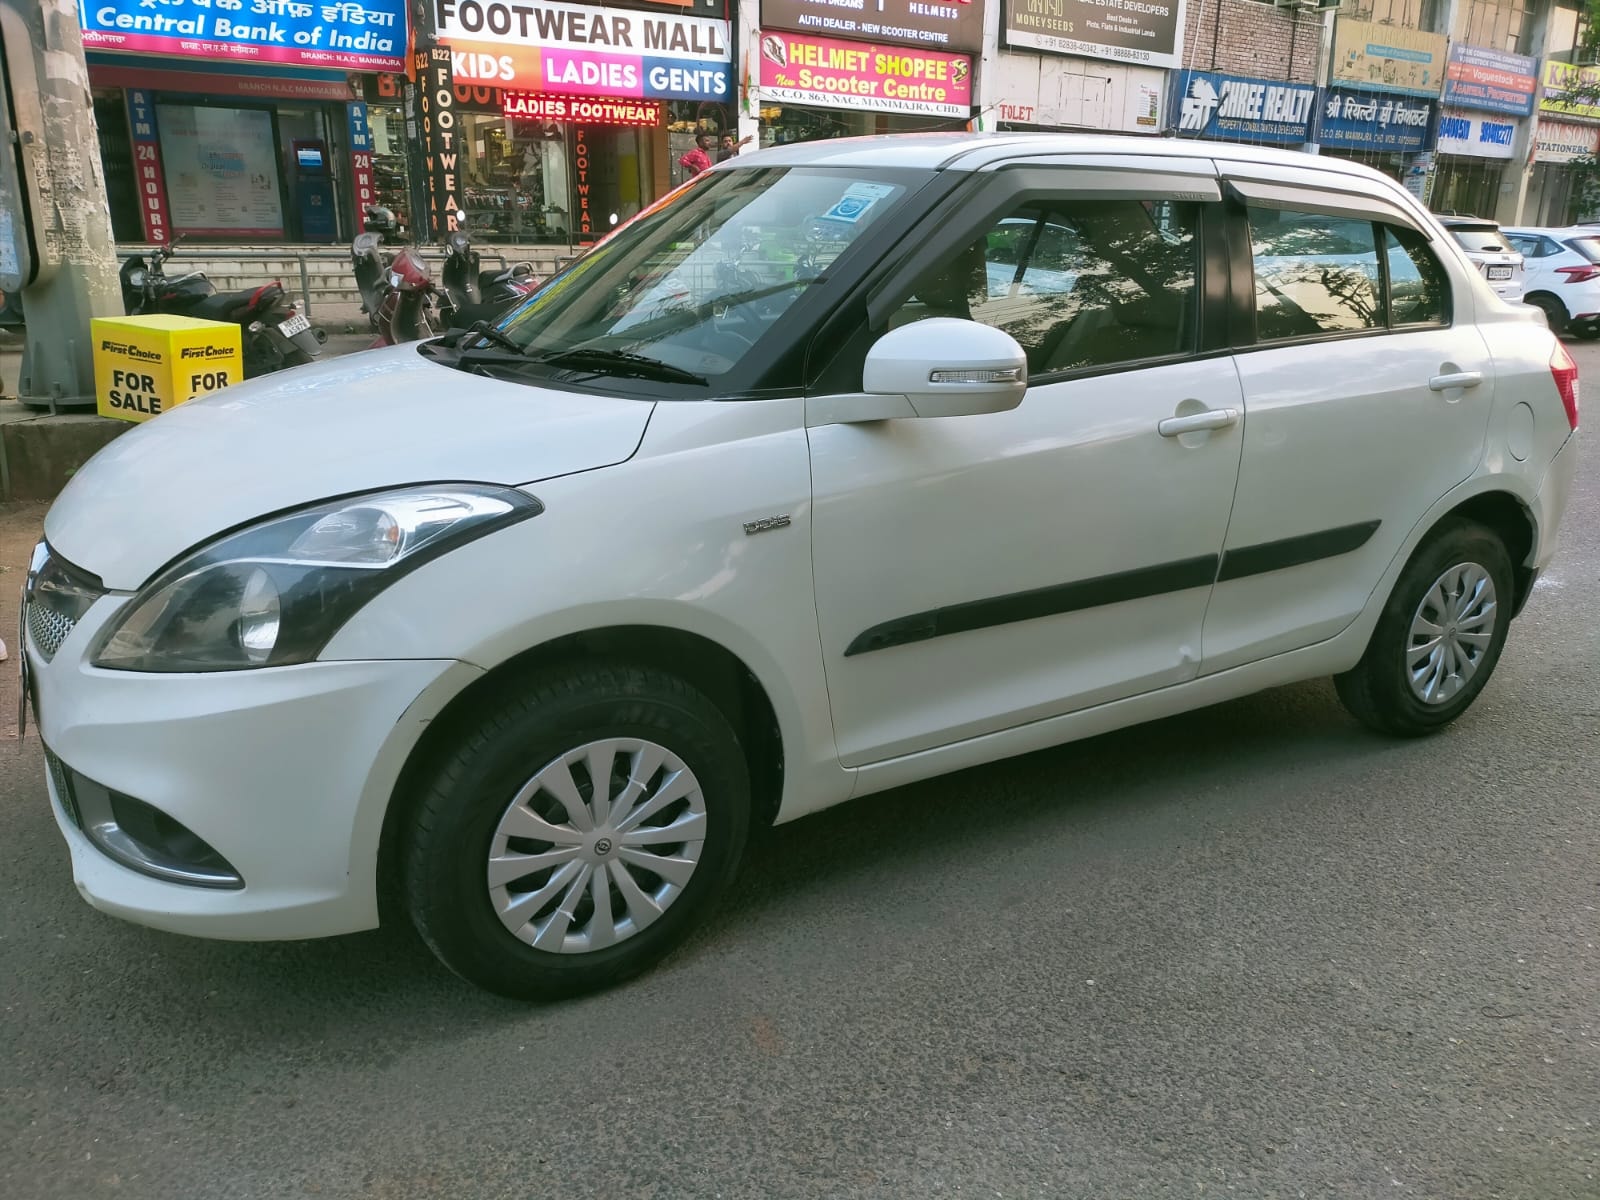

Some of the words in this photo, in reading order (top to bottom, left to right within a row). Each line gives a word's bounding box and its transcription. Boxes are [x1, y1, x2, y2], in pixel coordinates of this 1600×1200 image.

[320, 2, 395, 27] इंडिया
[910, 2, 959, 19] HELMETS
[1124, 1, 1169, 17] DEVELOPERS
[96, 7, 205, 34] Central
[214, 18, 287, 42] Bank
[293, 26, 322, 45] of
[329, 29, 393, 52] India
[437, 0, 633, 48] FOOTWEAR
[643, 19, 725, 55] MALL
[799, 14, 822, 26] AUTH
[823, 18, 857, 31] DEALER
[861, 24, 881, 35] NEW
[881, 27, 918, 40] SCOOTER
[918, 31, 949, 43] CENTRE
[1015, 13, 1075, 33] MONEYSEEDS
[300, 51, 335, 61] BRANCH:
[358, 58, 401, 67] MANIMAJRA
[432, 48, 450, 61] B22
[789, 42, 870, 73] HELMET
[875, 53, 947, 81] SHOPEE
[452, 52, 515, 80] KIDS
[546, 58, 638, 88] LADIES
[649, 67, 727, 94] GENTS
[1473, 68, 1514, 86] Voguestock
[774, 73, 796, 86] New
[799, 69, 879, 96] Scooter
[884, 79, 946, 102] Centre
[134, 91, 151, 136] ATM
[506, 98, 566, 115] LADIES
[570, 102, 656, 122] FOOTWEAR
[771, 89, 807, 101] S.C.O.
[935, 104, 961, 115] CHD.
[1000, 104, 1034, 122] TOLET
[1218, 80, 1266, 120] SHREE
[1262, 85, 1315, 123] REALTY
[1326, 95, 1342, 119] श्री
[1343, 96, 1378, 122] रियल्टी
[352, 106, 366, 146] ATM
[1218, 120, 1241, 130] PROPERTY
[1242, 122, 1274, 134] CONSULTANTS
[1278, 125, 1305, 137] DEVELOPERS
[1565, 124, 1598, 147] SONS
[138, 145, 155, 160] 24
[421, 76, 438, 232] FOOTWEAR
[435, 68, 459, 232] FOOTWEAR
[1535, 141, 1589, 155] STATIONERS
[354, 154, 369, 168] 24
[576, 130, 591, 234] FOOTWEAR
[143, 166, 164, 241] HOURS
[101, 340, 128, 355] First
[127, 344, 162, 361] Choice
[180, 347, 205, 360] First
[204, 345, 235, 357] Choice
[113, 370, 155, 394] FOR
[191, 371, 228, 392] FOR
[110, 391, 162, 415] SALE
